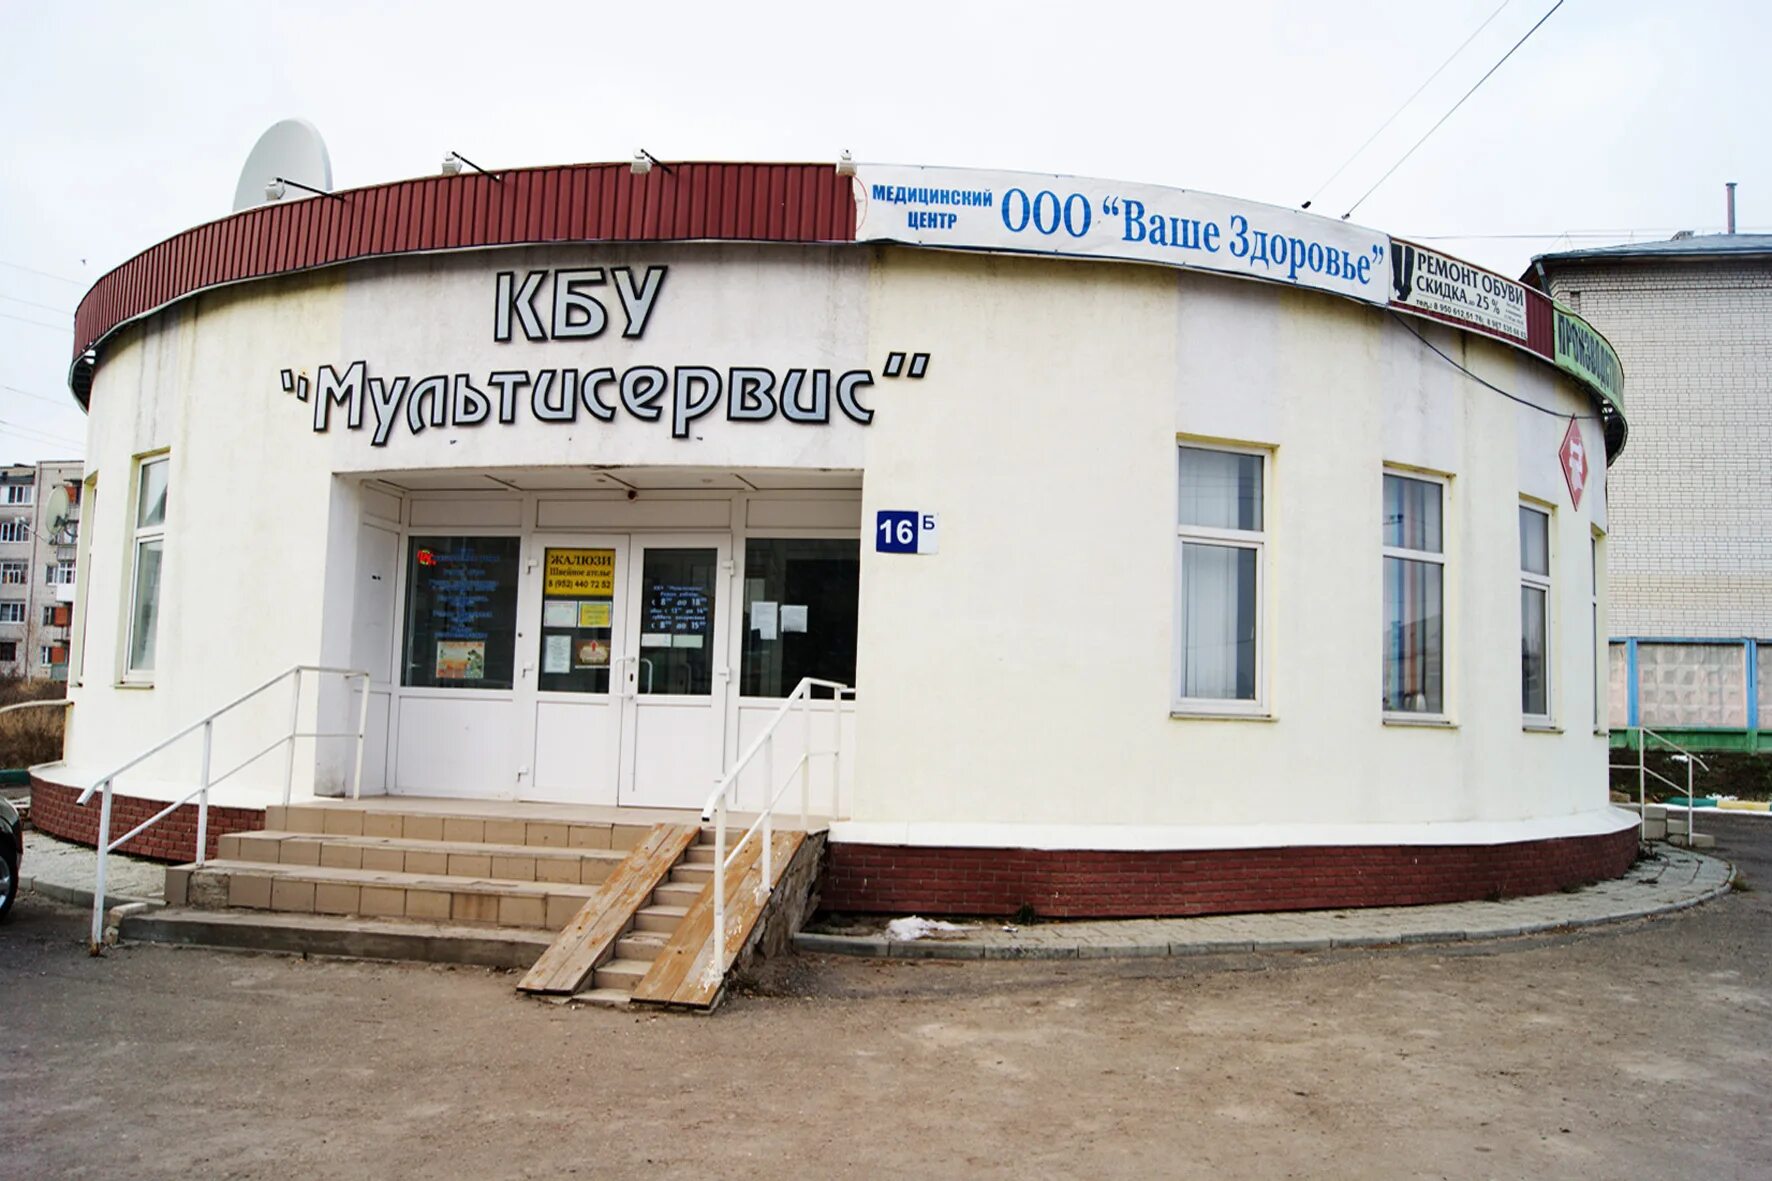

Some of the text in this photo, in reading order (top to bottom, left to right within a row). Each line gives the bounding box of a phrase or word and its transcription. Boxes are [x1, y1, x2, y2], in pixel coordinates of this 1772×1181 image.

[872, 184, 992, 207] МЕДИЦИНСКИЙ
[908, 211, 957, 230] ЦЕНТР
[1001, 188, 1092, 238] ООО
[1416, 275, 1468, 304] СКИДКА
[1476, 293, 1490, 310] 25
[1417, 252, 1524, 306] РЕМОНТ ОБУВИ
[494, 265, 668, 343] КБУ
[880, 519, 914, 544] 16
[551, 555, 611, 566] ЖАЛЮЗИ
